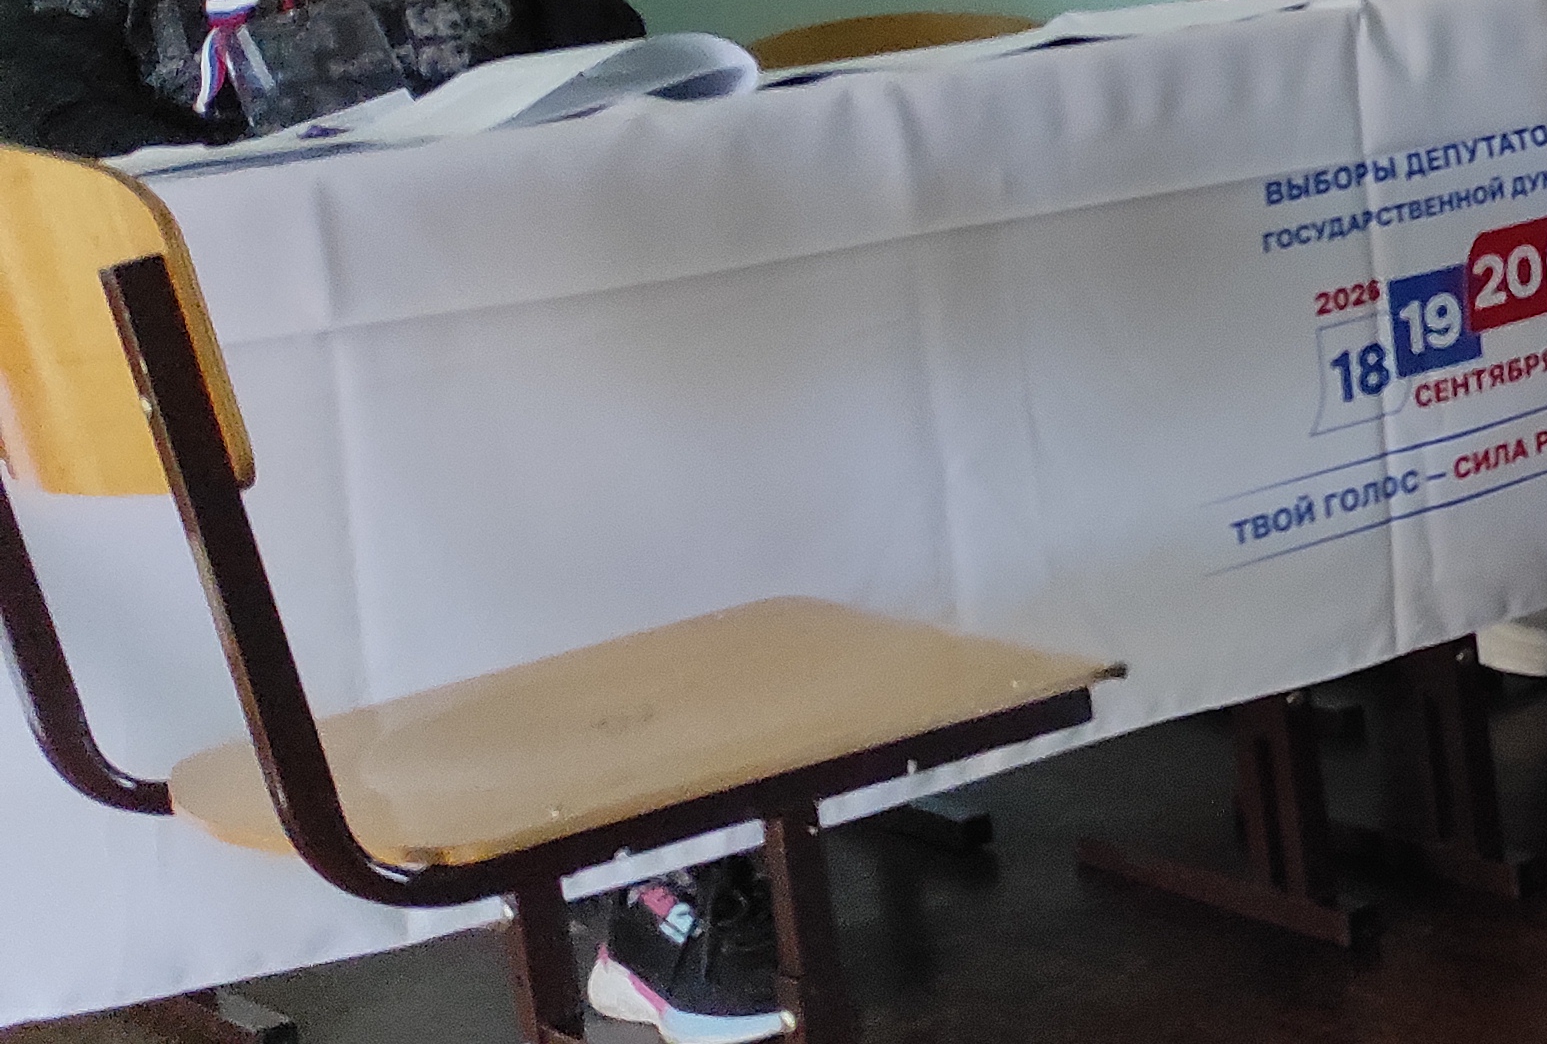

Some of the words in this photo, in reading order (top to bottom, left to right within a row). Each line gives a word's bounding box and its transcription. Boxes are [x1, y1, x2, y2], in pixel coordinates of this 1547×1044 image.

[1262, 178, 1505, 253] ГОСУДАРСТВЕННОЙ
[1265, 160, 1397, 207] ВЫБОРЫ
[1315, 279, 1381, 317] 2026
[1473, 244, 1543, 311] 20
[1400, 292, 1464, 356] 19
[1331, 342, 1391, 403] 18
[1231, 496, 1316, 546] ТВОЙ
[1324, 469, 1420, 518] ГОЛОС
[1454, 444, 1530, 481] СИЛА
